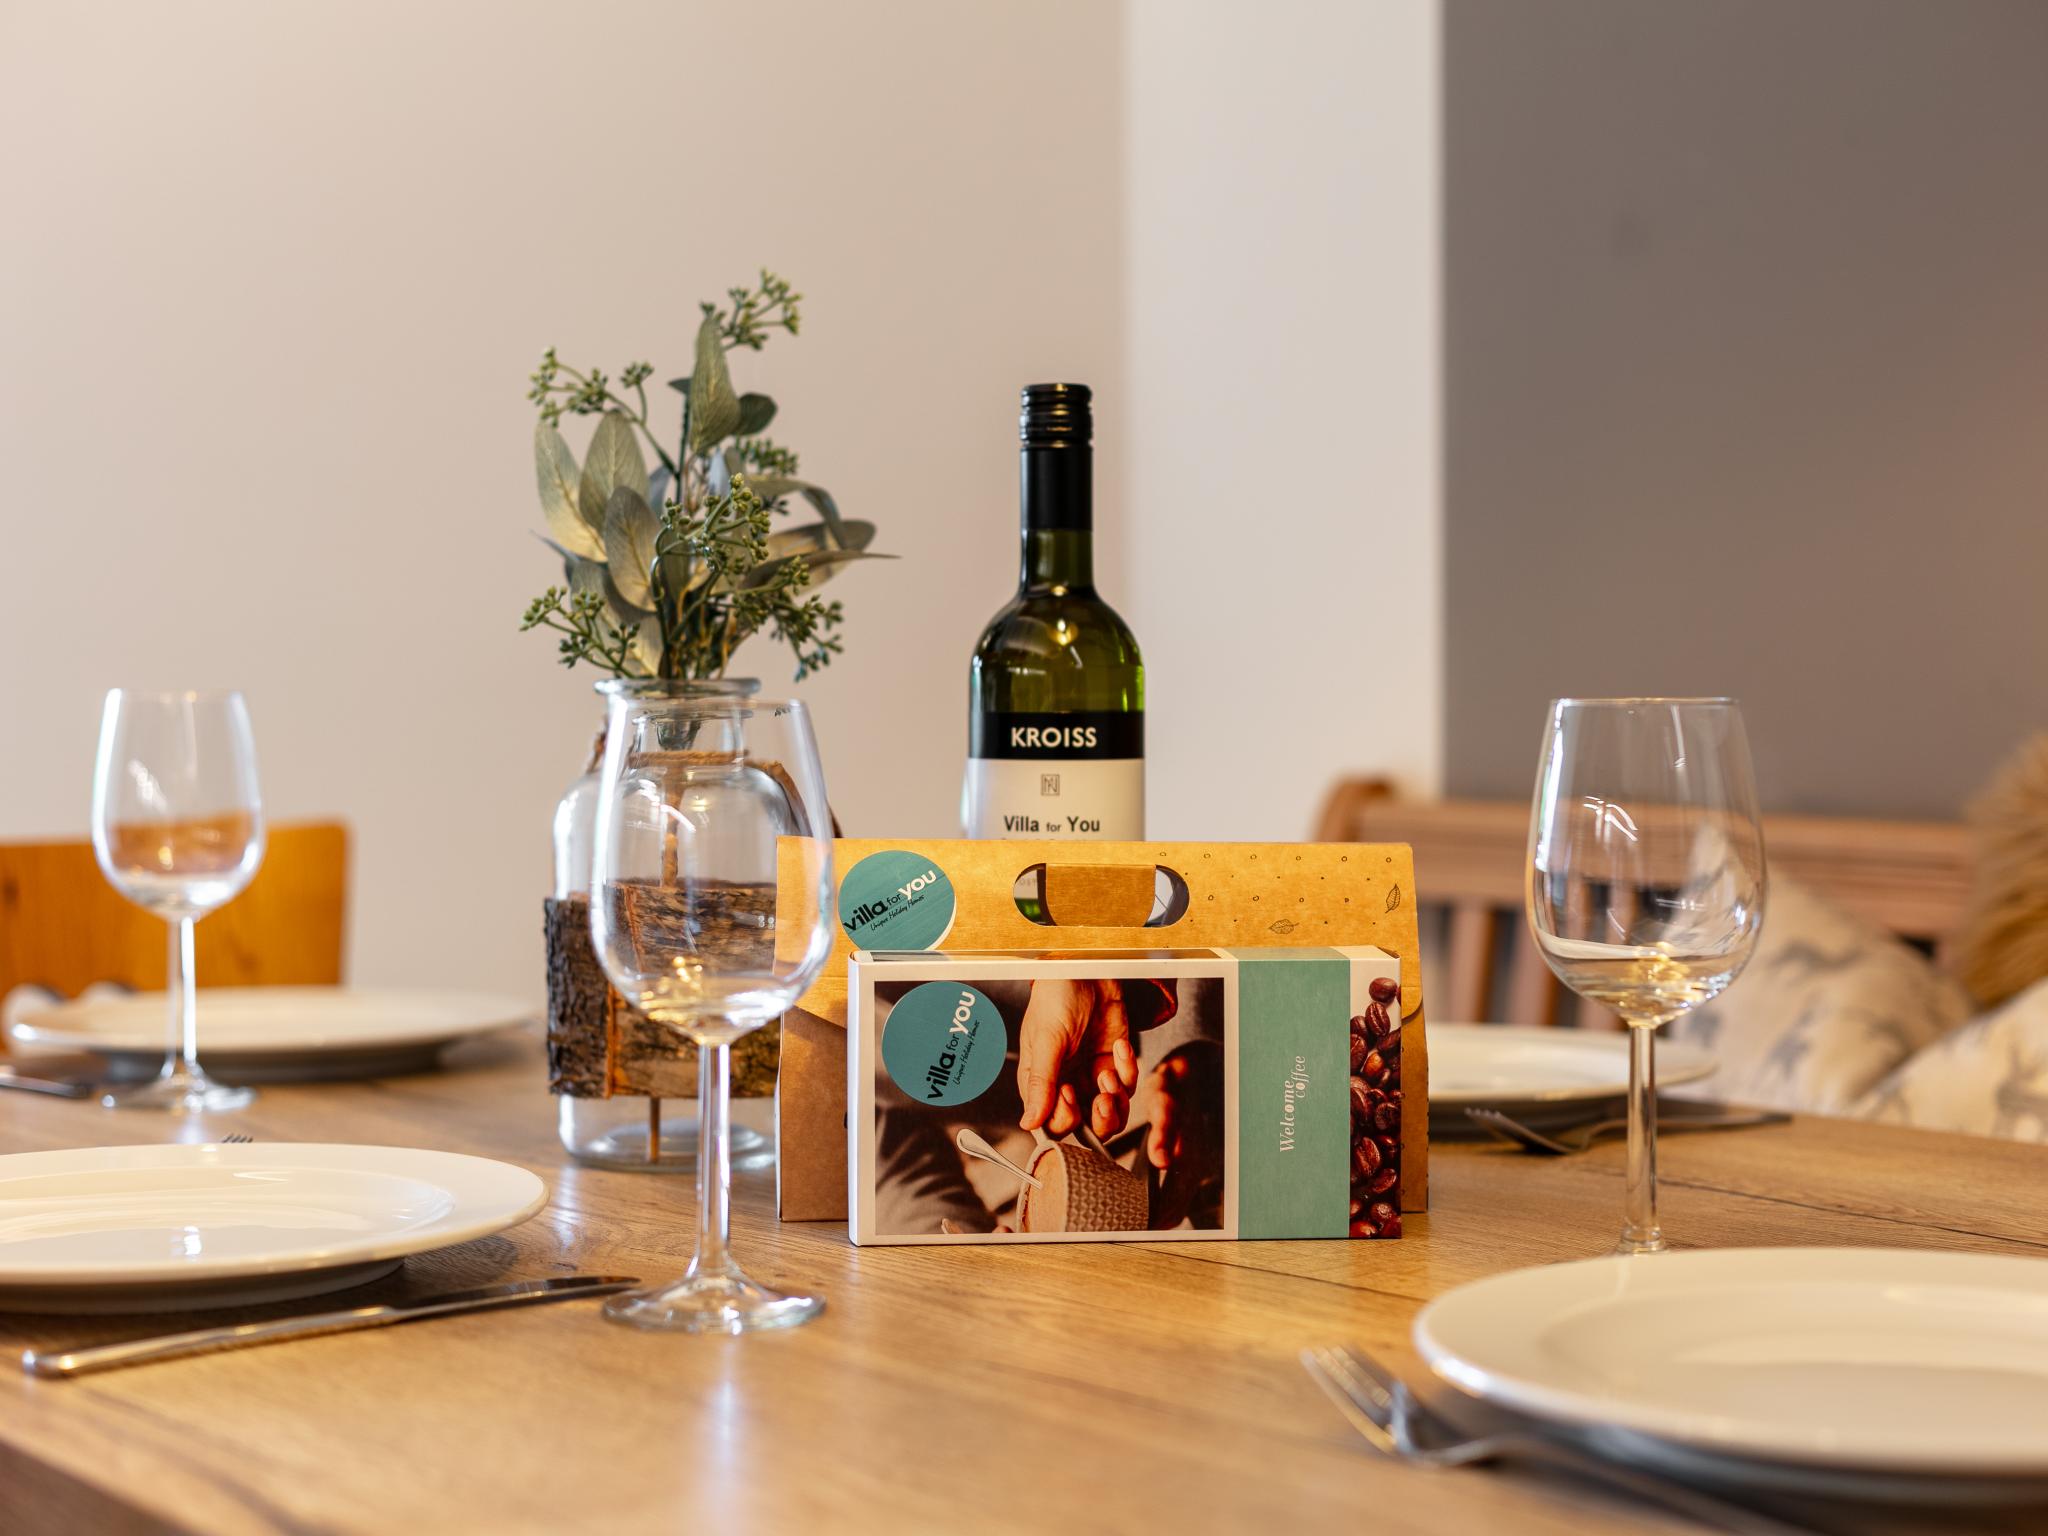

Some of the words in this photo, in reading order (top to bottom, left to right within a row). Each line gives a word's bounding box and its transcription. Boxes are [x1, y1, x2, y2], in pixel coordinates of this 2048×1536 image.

[1011, 727, 1097, 747] KROISS
[1004, 815, 1039, 832] Villa
[1046, 822, 1061, 832] for
[1067, 815, 1100, 832] You
[843, 900, 888, 931] villa
[887, 893, 902, 907] for
[898, 870, 937, 900] you
[888, 904, 908, 921] Holiday
[949, 991, 976, 1035] you
[946, 1033, 960, 1051] for
[960, 1040, 975, 1064] Holiday
[926, 1052, 956, 1099] villa
[1291, 1056, 1311, 1098] coffee
[1280, 1080, 1295, 1152] Welcome
